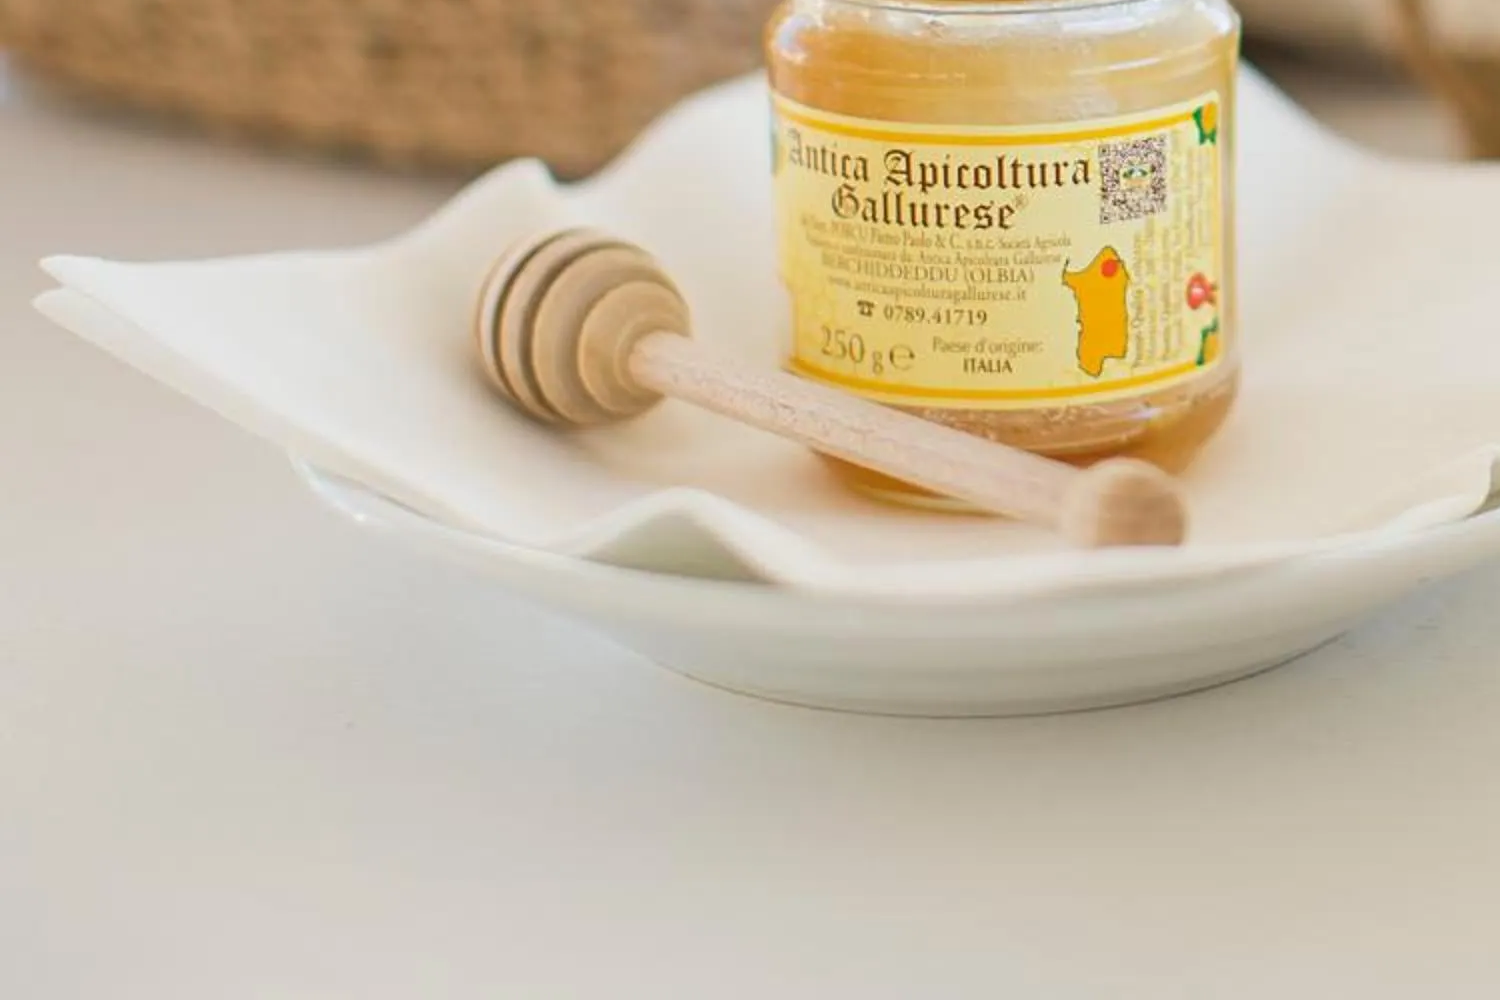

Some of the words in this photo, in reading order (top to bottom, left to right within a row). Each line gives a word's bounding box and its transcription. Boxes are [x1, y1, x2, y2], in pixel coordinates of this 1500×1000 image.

[787, 128, 869, 182] Antica
[884, 149, 1092, 193] Apicoltura
[964, 267, 1035, 284] (OLBIA)
[883, 304, 988, 325] 0789.41719
[821, 325, 865, 364] 250
[872, 350, 884, 375] g
[932, 336, 970, 353] Paese
[963, 358, 1013, 374] ITALIA
